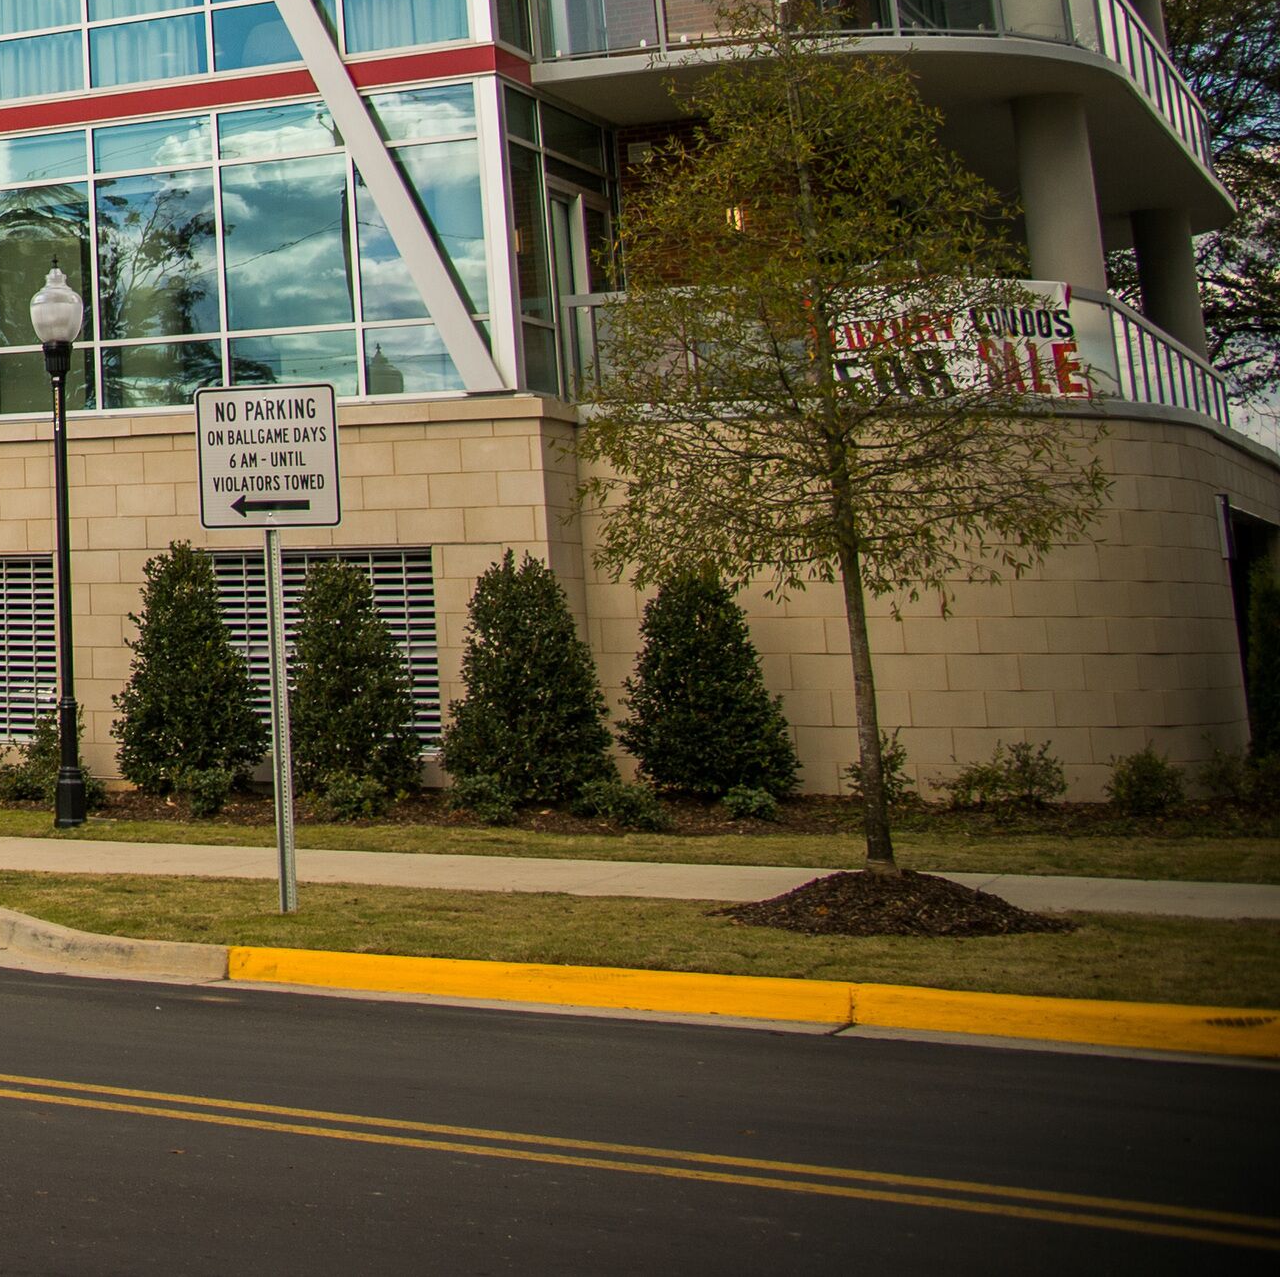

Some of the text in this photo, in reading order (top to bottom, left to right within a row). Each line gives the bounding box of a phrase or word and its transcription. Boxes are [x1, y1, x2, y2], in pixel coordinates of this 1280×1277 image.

[977, 339, 1084, 394] SALE
[215, 397, 317, 423] NO PARKING
[207, 425, 327, 446] ON BALLGAME DAYS
[229, 453, 237, 469] 6
[240, 452, 258, 469] AM
[270, 450, 307, 468] UNTIL
[213, 473, 325, 493] VIOLATORS TOWED
